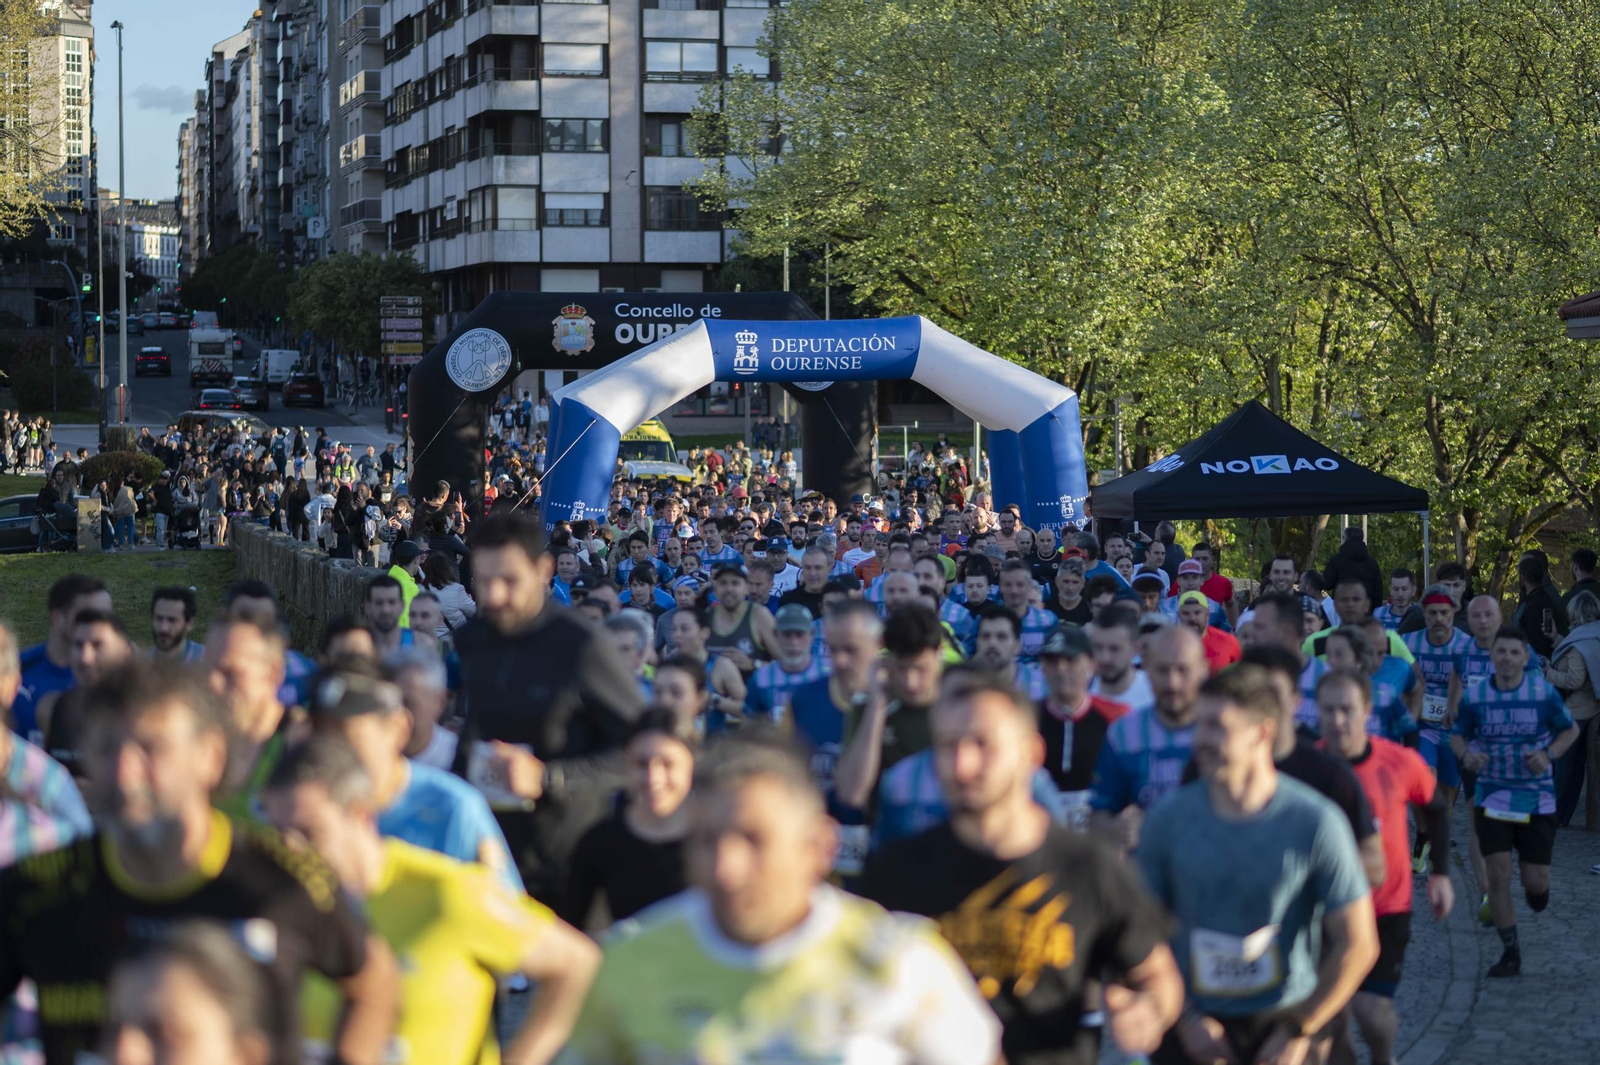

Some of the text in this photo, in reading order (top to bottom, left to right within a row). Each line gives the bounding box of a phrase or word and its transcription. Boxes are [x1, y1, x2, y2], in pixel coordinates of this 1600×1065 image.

[615, 303, 722, 318] Concello de
[771, 333, 897, 353] DEPUTACIÓN
[451, 332, 507, 378] CONSELLO MUNICIPAL DE DEPORTES
[770, 356, 863, 371] OURENSE
[1200, 454, 1340, 475] NOKAO
[1481, 723, 1537, 736] OURENSE
